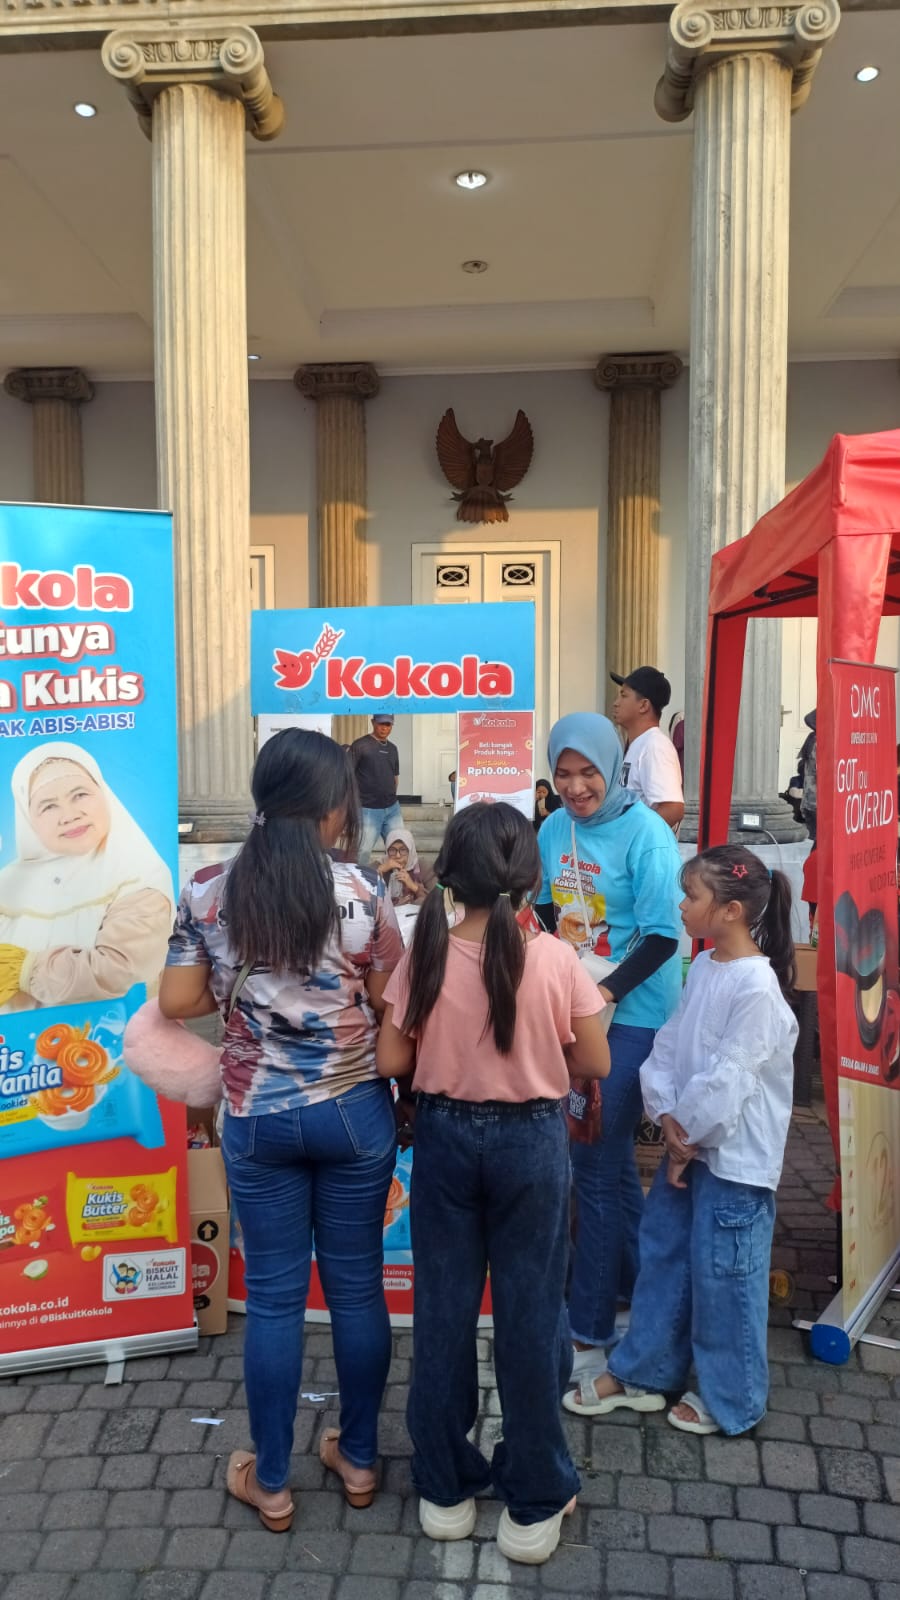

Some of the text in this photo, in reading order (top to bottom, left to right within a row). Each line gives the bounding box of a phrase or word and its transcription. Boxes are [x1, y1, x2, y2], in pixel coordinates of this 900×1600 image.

[326, 655, 515, 698] Kokola
[24, 668, 140, 707] Kukis
[850, 683, 880, 719] OMG
[30, 713, 135, 735] ABIS-ABIS!
[467, 766, 525, 777] Rp10.000,-
[0, 1065, 62, 1095] anila
[87, 1192, 123, 1204] Kukis
[82, 1203, 128, 1217] Butter
[146, 1265, 179, 1275] BISKUIT
[146, 1273, 179, 1282] HALAL
[29, 1316, 38, 1325] di
[39, 1307, 113, 1324] @BiskuitKokola
